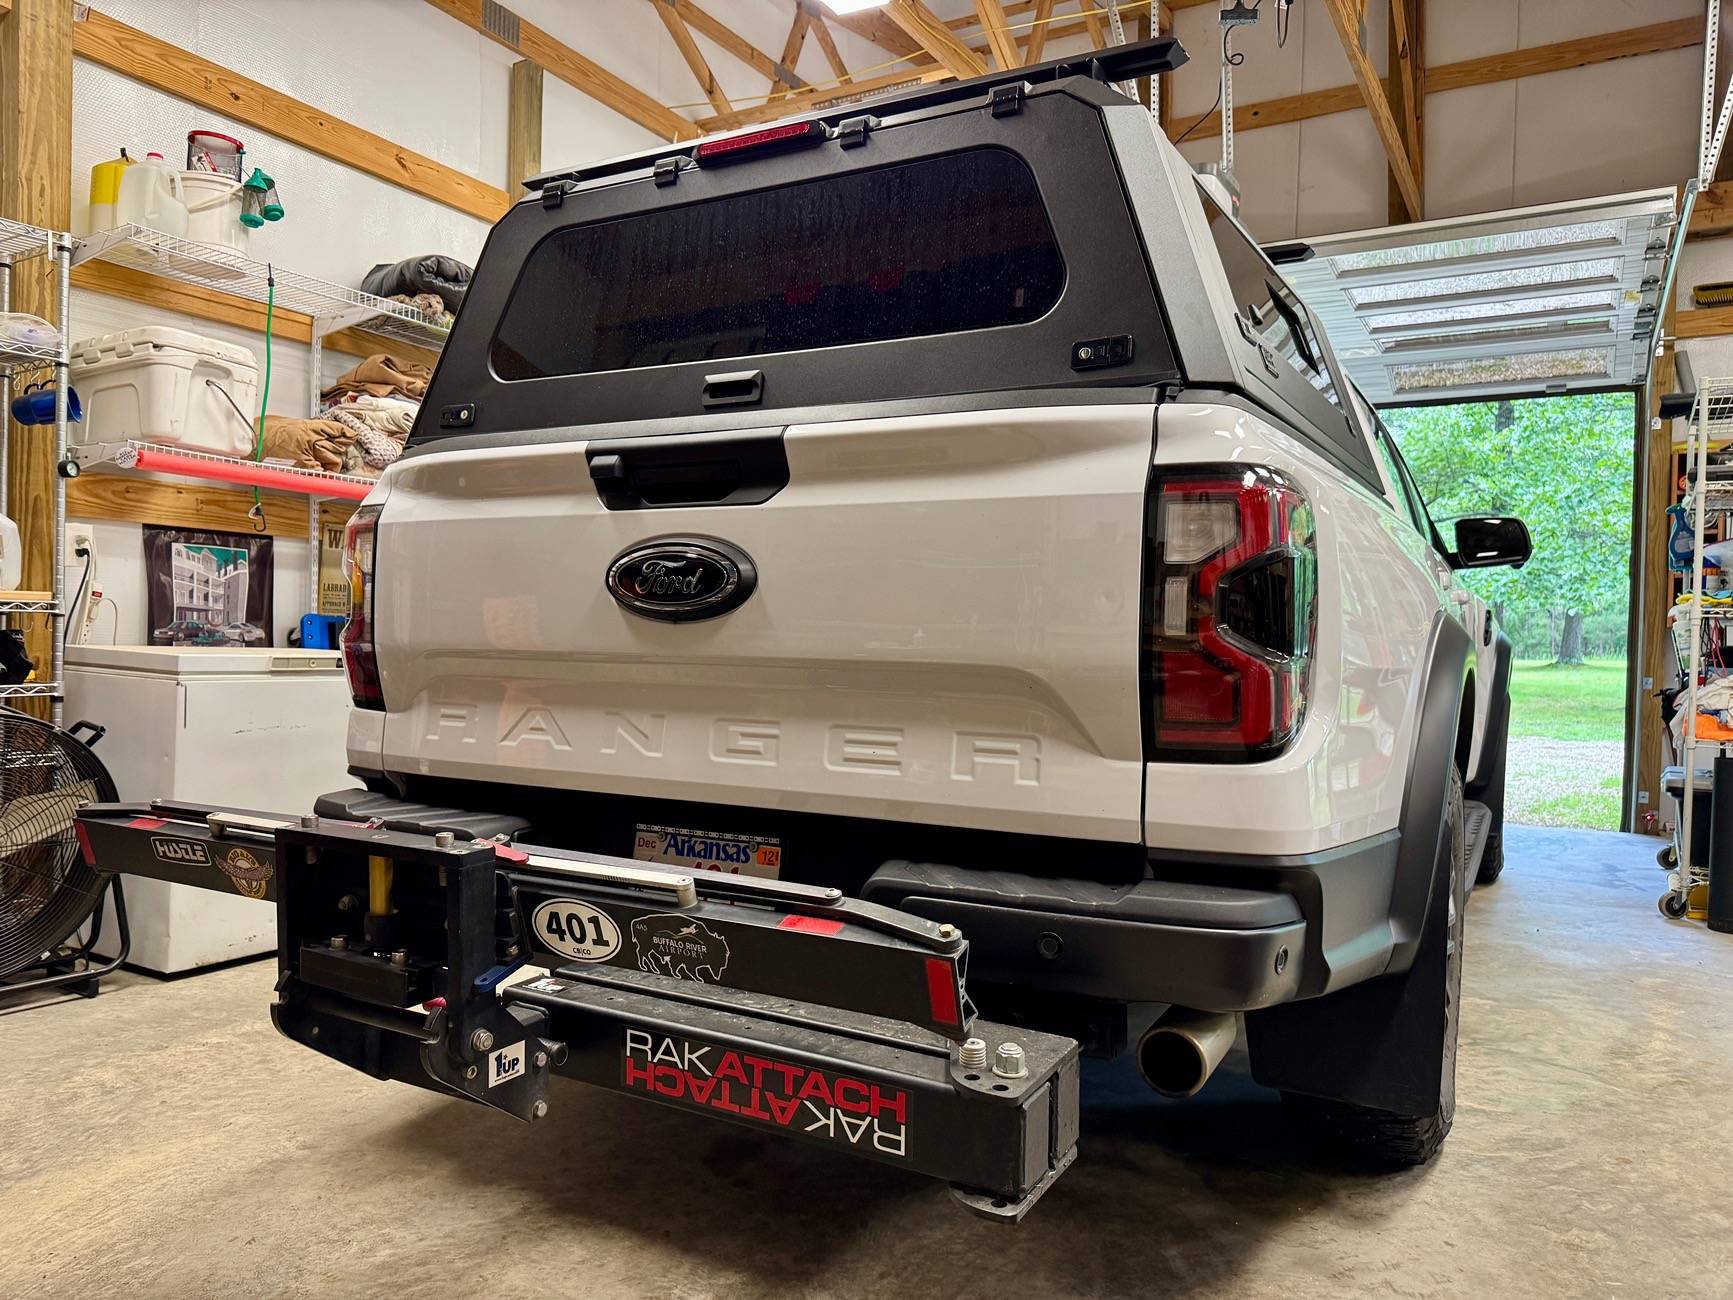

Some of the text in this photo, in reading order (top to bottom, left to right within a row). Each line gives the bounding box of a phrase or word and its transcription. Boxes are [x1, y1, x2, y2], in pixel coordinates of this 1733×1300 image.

[327, 528, 344, 549] W
[635, 560, 703, 594] Ford
[323, 583, 347, 593] LABRAD
[425, 703, 1041, 787] RANGER
[155, 841, 206, 861] HUSTLE
[638, 837, 657, 849] Dec
[663, 833, 751, 864] Arkansas
[546, 911, 610, 947] 401
[653, 936, 707, 953] BUFFALO RIVER
[658, 944, 704, 959] AIRPORT
